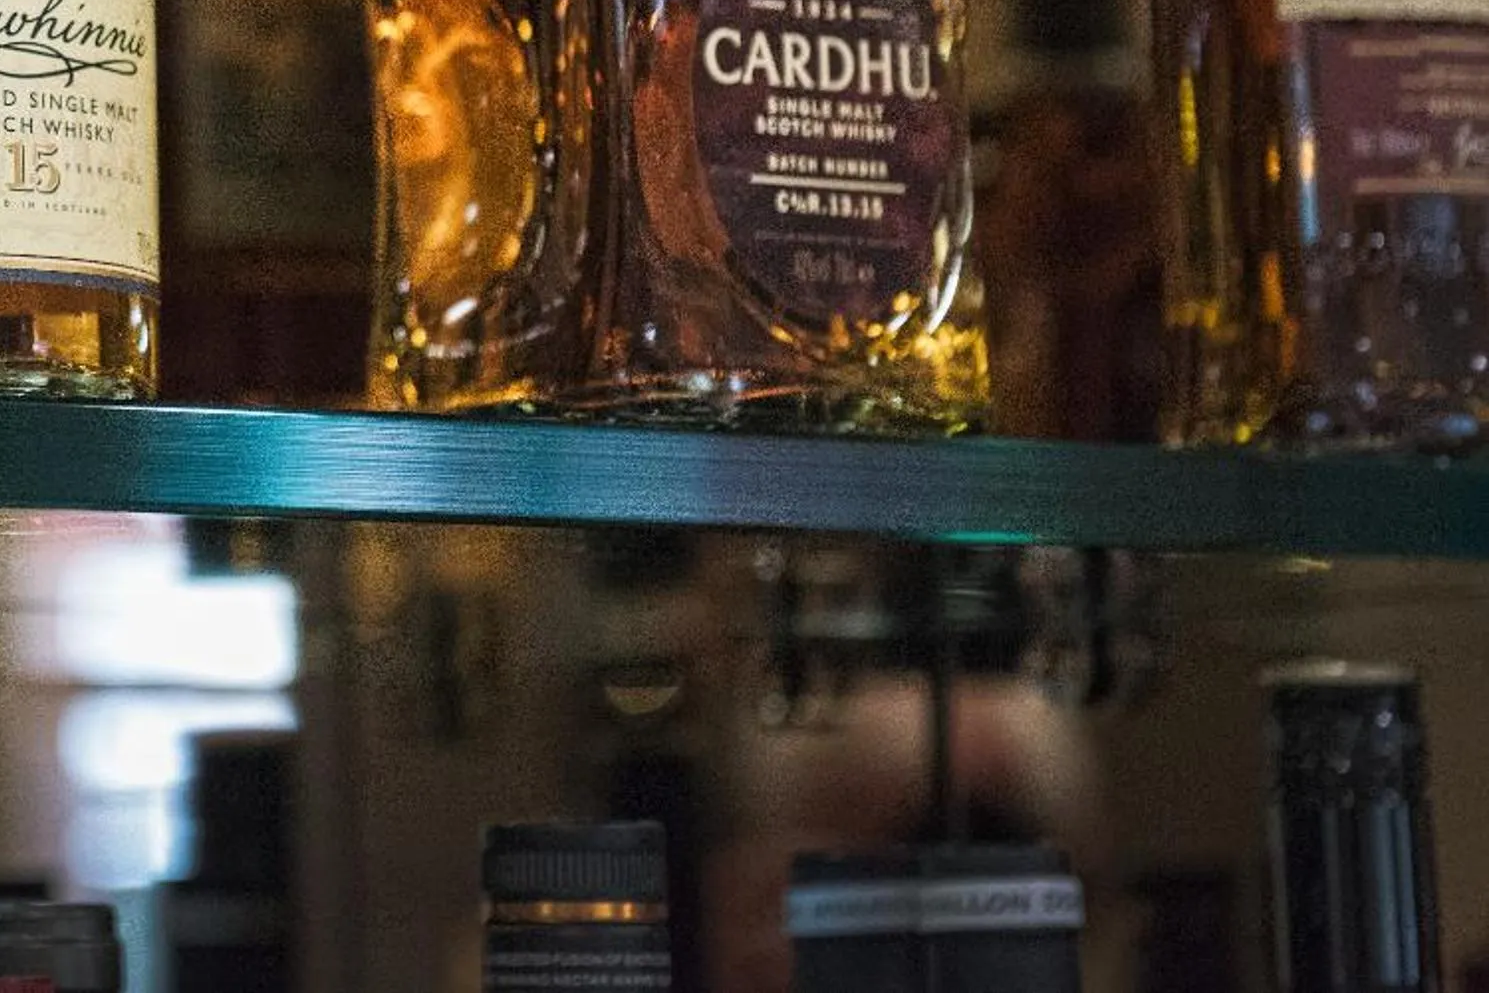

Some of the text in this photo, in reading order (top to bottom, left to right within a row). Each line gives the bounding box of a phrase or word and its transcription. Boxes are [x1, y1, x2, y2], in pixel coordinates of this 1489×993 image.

[702, 26, 931, 101] CARDHU
[29, 93, 100, 116] SINGLE
[104, 100, 139, 125] MALT
[766, 96, 885, 122] SINGLE MALT
[42, 120, 116, 143] WHISKY
[754, 114, 897, 144] SCOTCH WHISKY
[3, 140, 62, 195] 15
[766, 153, 889, 179] BATCH NUMBER
